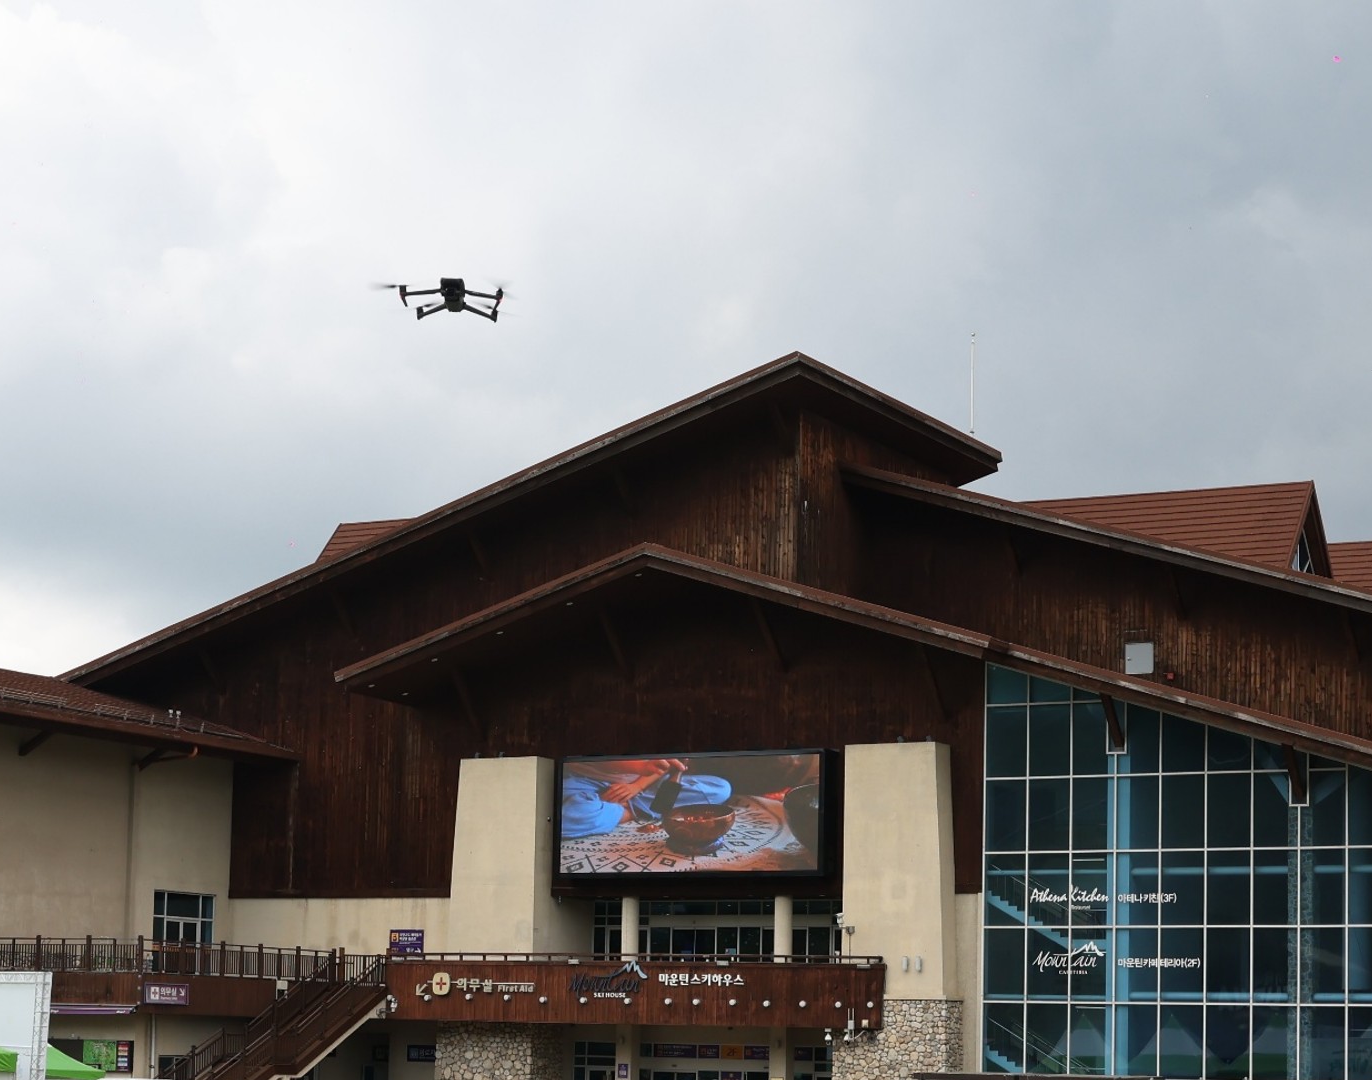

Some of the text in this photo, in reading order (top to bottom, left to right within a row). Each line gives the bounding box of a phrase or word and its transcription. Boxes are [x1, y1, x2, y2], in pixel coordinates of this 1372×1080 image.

[1030, 883, 1110, 904] Athena Kitchen
[1032, 947, 1099, 973] Mountain
[160, 986, 177, 997] 의무실
[456, 977, 493, 993] 의무실
[497, 984, 534, 993] First Aid
